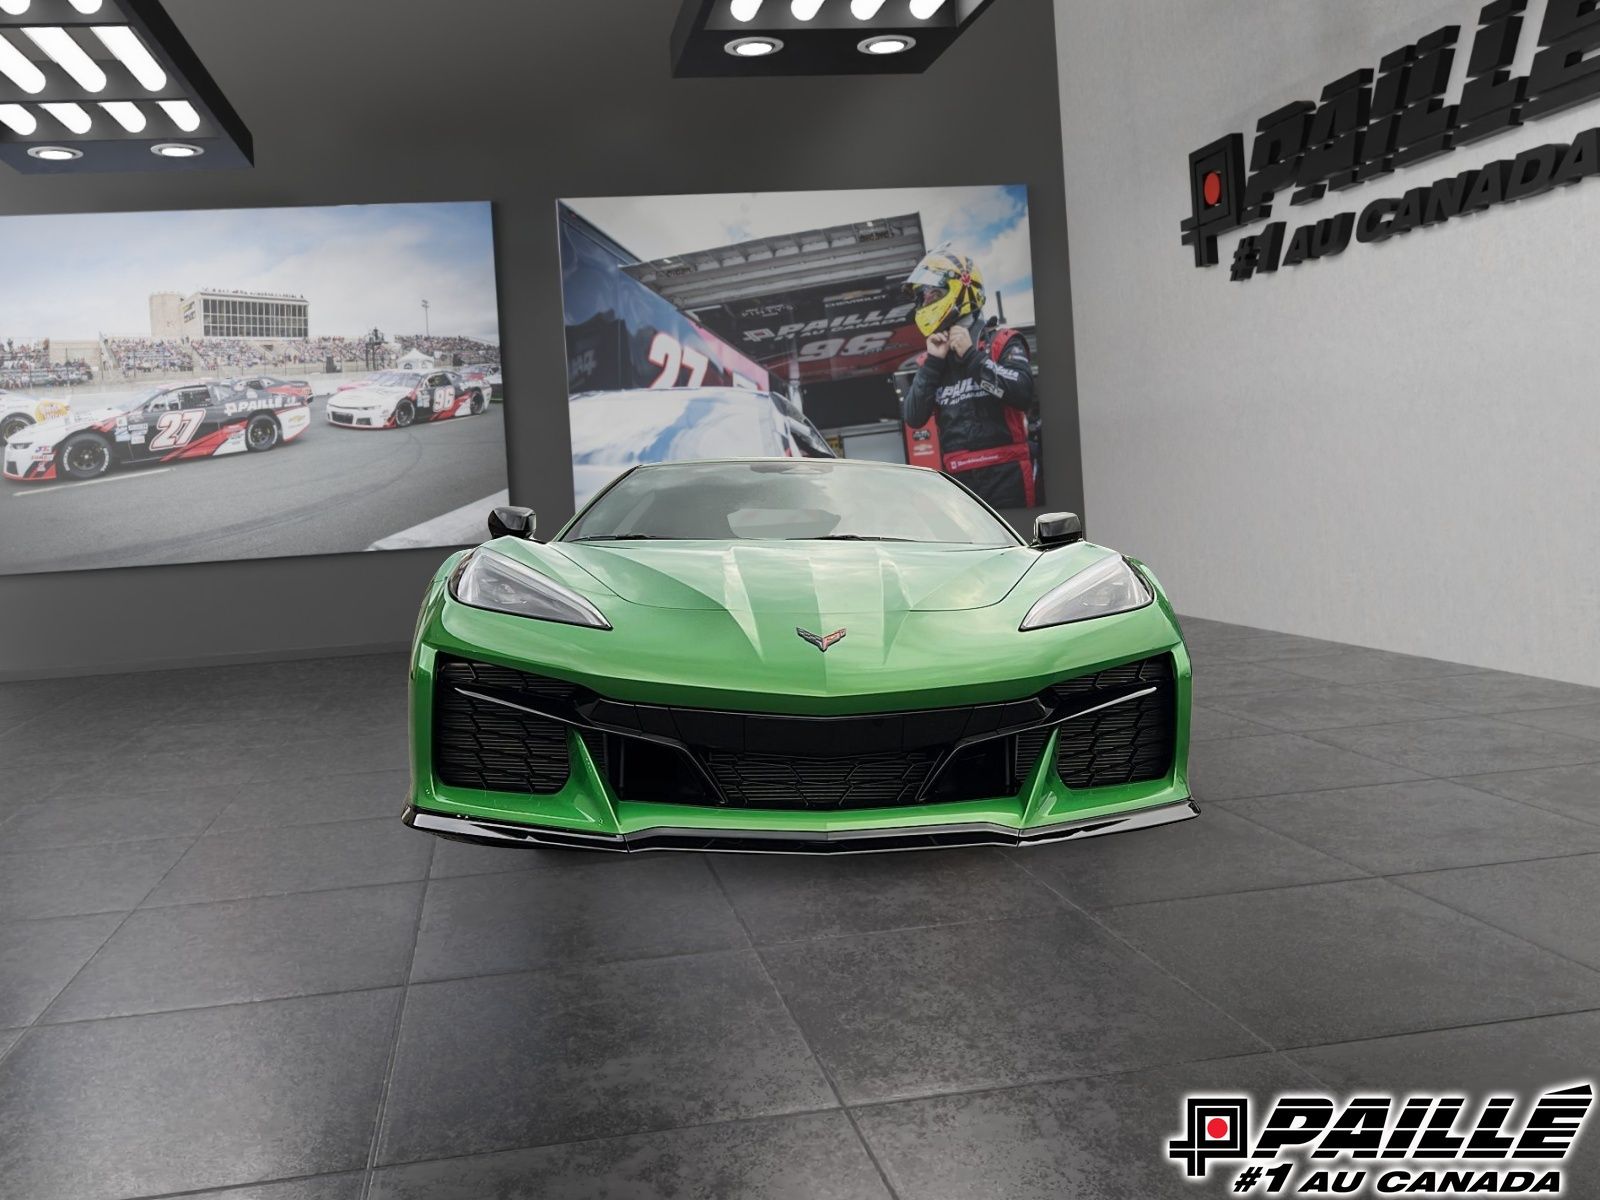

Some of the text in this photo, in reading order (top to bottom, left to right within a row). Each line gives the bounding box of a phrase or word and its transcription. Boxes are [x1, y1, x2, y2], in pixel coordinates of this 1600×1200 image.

[1230, 127, 1600, 281] #1 AU CANADA
[649, 332, 708, 389] 27
[798, 331, 893, 362] 96
[433, 386, 455, 412] 96
[149, 408, 206, 451] 27
